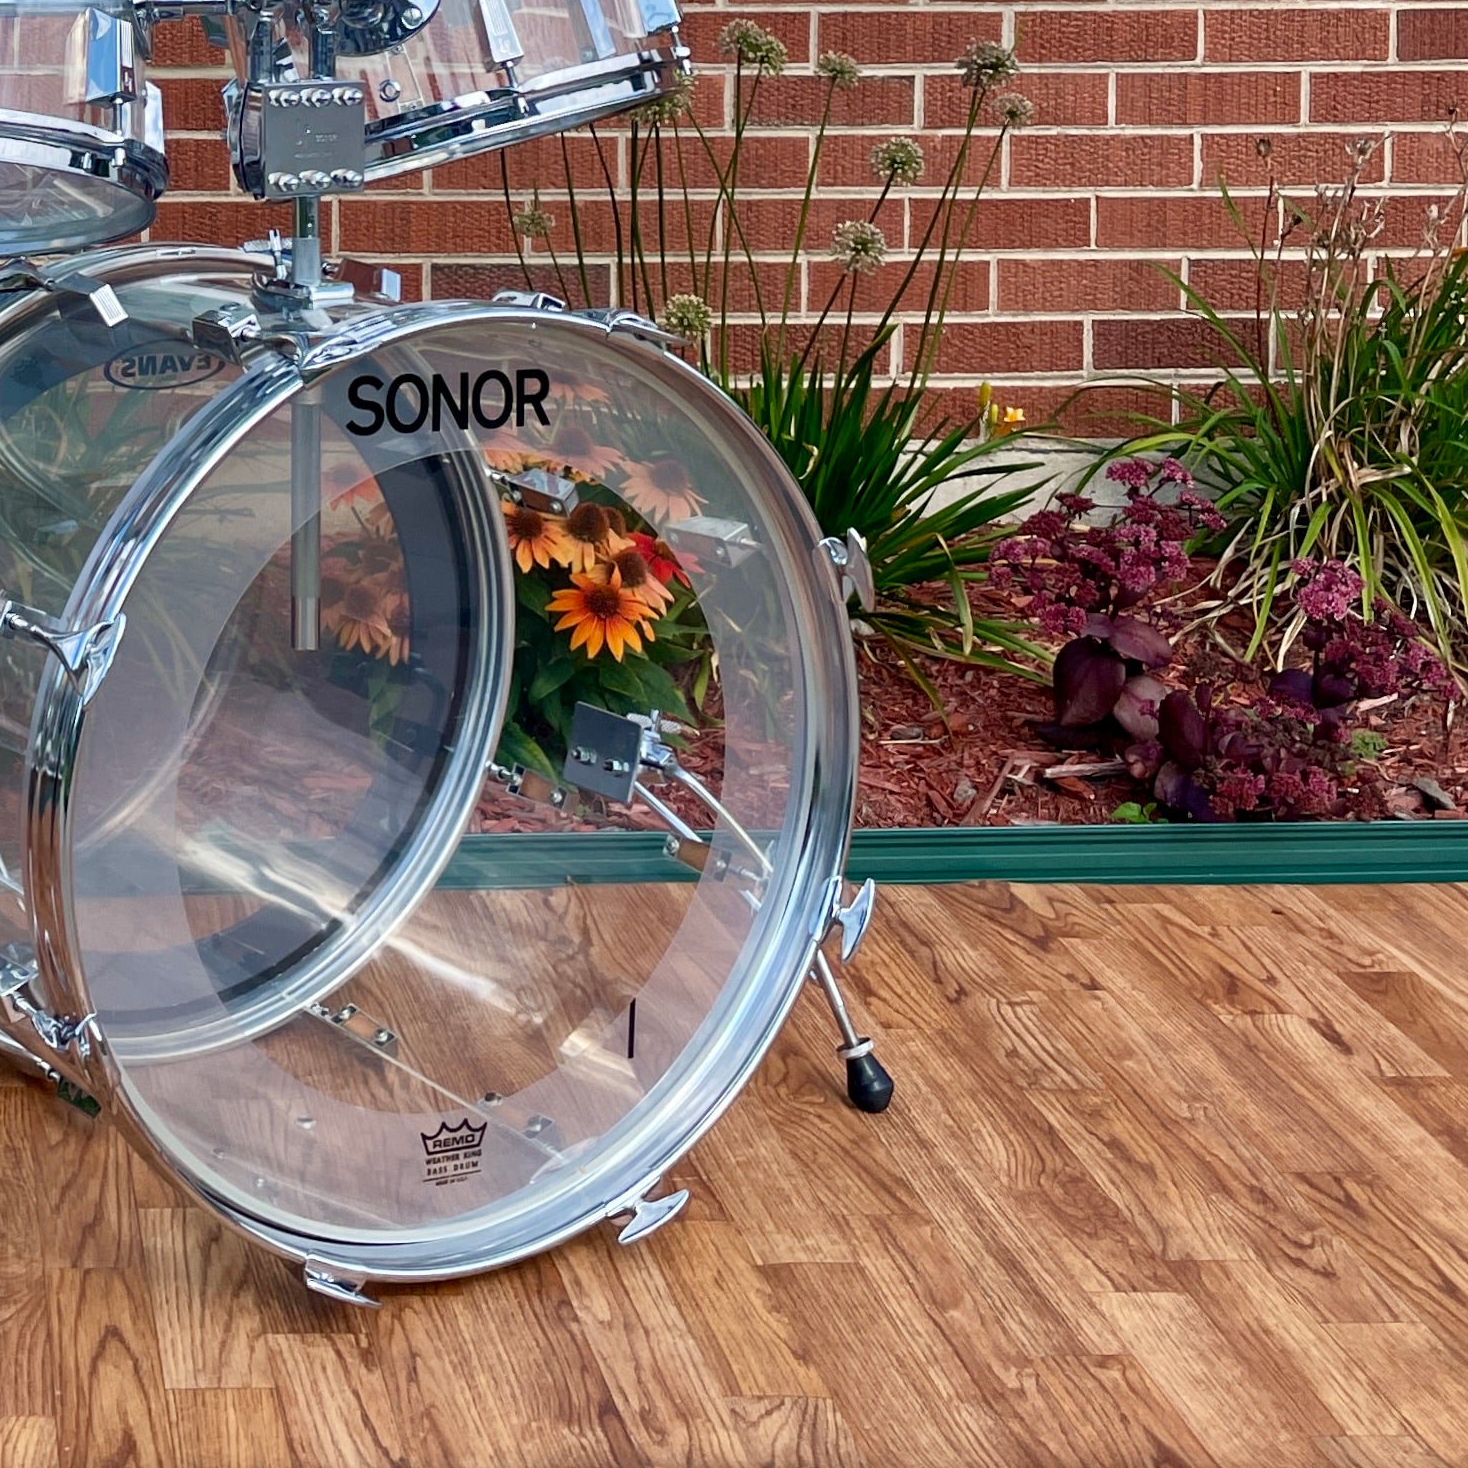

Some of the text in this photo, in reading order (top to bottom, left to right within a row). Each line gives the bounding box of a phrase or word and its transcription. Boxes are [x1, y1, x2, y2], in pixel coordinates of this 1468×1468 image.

[345, 368, 552, 436] SONOR
[432, 1133, 476, 1149] REMO
[425, 1148, 482, 1166] WEATHER KING
[426, 1160, 479, 1177] BASS DRUM
